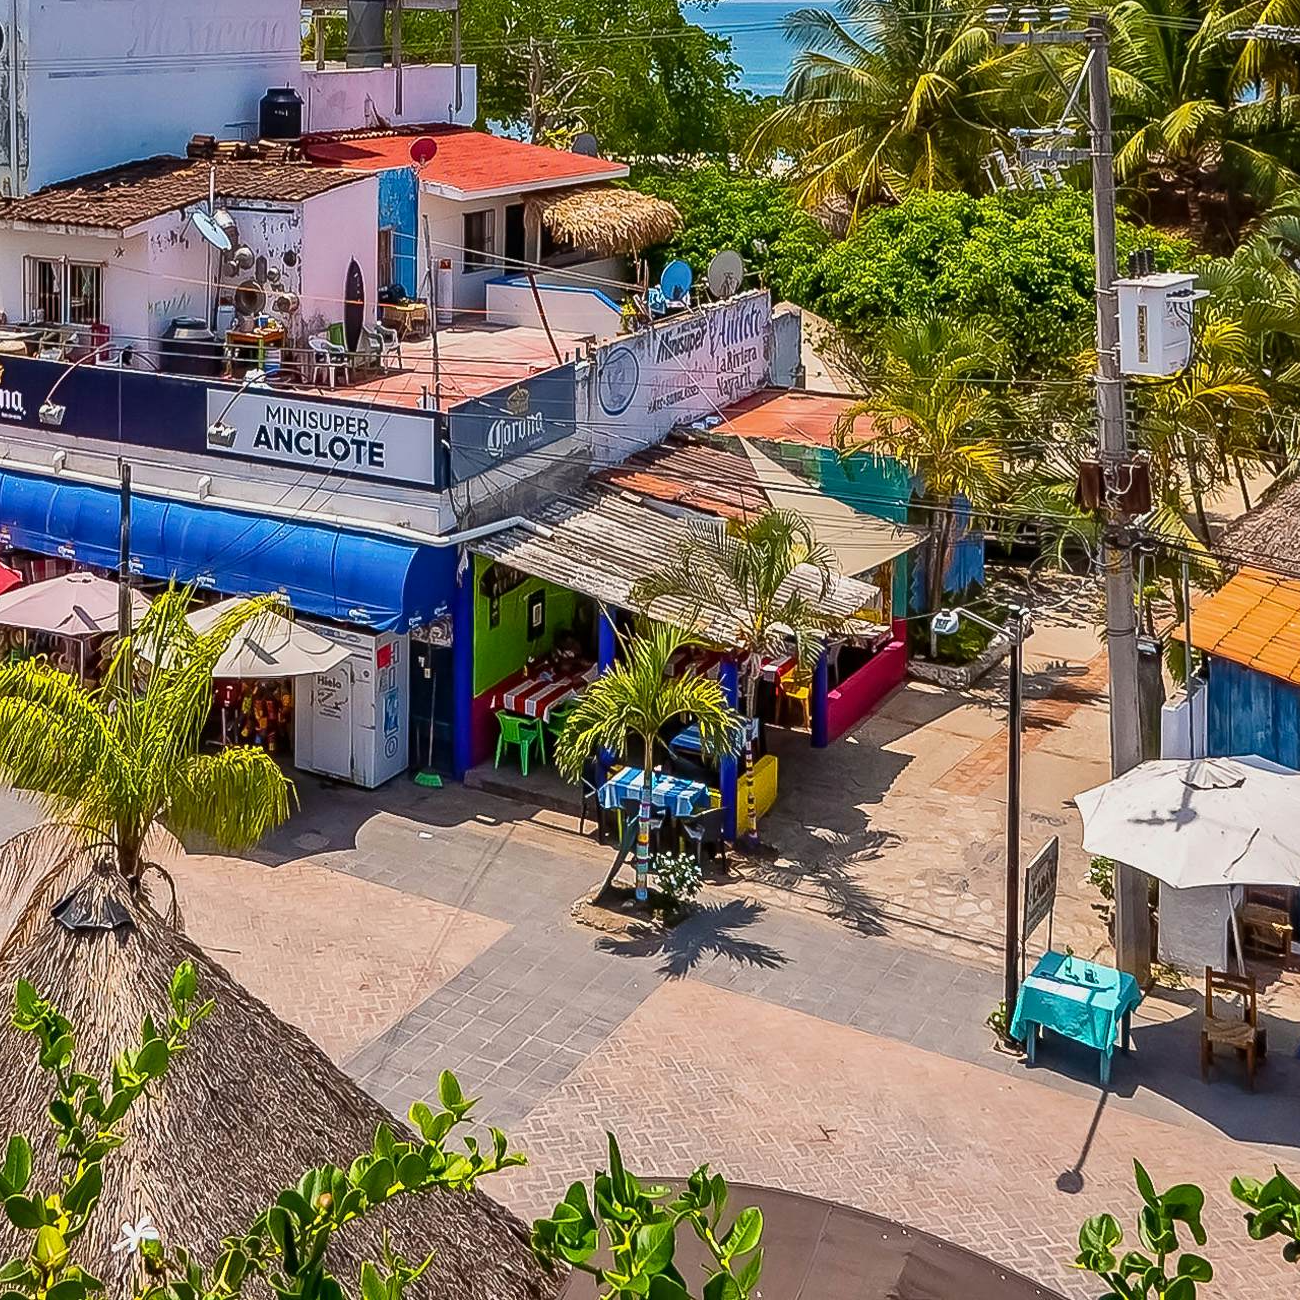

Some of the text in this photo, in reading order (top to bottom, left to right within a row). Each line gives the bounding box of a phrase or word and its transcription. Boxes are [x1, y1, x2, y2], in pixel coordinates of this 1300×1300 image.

[266, 404, 369, 437] MINISUPER
[487, 412, 546, 458] Corona
[253, 425, 385, 468] ANCLOTE
[317, 674, 343, 690] Hielo
